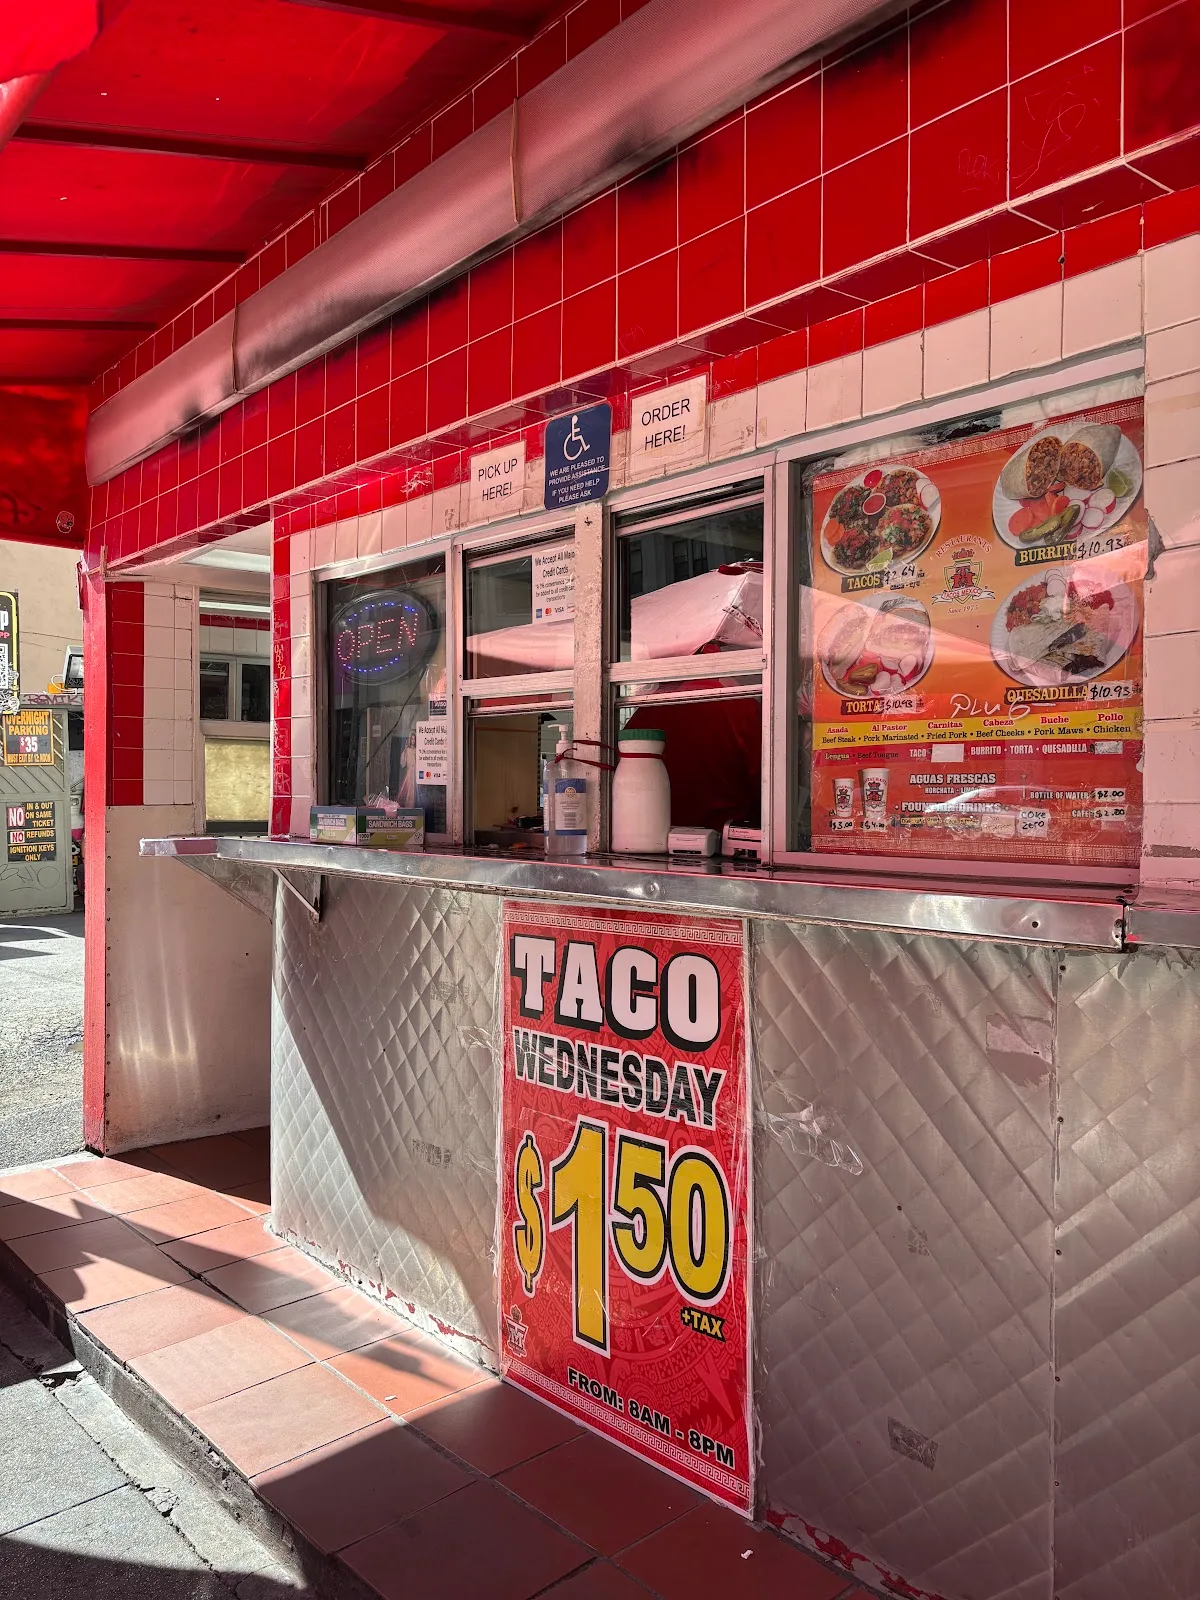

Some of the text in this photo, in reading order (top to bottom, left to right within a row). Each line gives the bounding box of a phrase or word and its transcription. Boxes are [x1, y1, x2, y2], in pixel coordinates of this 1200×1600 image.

[641, 399, 691, 427] ORDER
[644, 424, 686, 450] HERE!
[478, 458, 518, 481] PICK UP
[559, 466, 570, 474] ARE
[571, 459, 595, 471] PLEASED
[596, 455, 605, 463] TO
[548, 464, 606, 486] PROVIDE ASSISTANCE
[482, 482, 512, 501] HERE!
[558, 486, 569, 494] YOU
[569, 481, 584, 491] NEED
[585, 478, 600, 487] HELP
[559, 489, 592, 503] PLEASE ASK
[935, 534, 993, 559] RESTAURANTS
[542, 553, 557, 565] Accept
[543, 567, 556, 578] Credit
[847, 574, 881, 590] TACOS
[337, 612, 418, 661] OPEN
[1007, 685, 1089, 702] QUESADILLA
[846, 699, 881, 713] TORTA
[6, 711, 50, 725] OVERNIGHT
[871, 724, 880, 732] Al
[881, 724, 908, 732] Pastor
[927, 721, 963, 730] Carnitas
[983, 718, 1014, 727] Cabeza
[1040, 715, 1070, 725] Buche
[1097, 712, 1124, 722] Pollo
[8, 725, 49, 736] PARKING
[822, 736, 837, 744] Beef
[926, 731, 947, 740] Fried
[948, 731, 968, 739] Pork
[975, 729, 994, 739] Beef
[995, 728, 1025, 737] Cheeks
[1033, 728, 1055, 737] Pork
[1057, 726, 1084, 735] Maws
[1093, 724, 1132, 734] Chicken
[20, 736, 38, 753] $35
[909, 749, 927, 757] TACO
[970, 746, 1001, 755] BURRITO
[1009, 744, 1034, 754] TORTA
[1041, 743, 1088, 754] QUESADILLA
[909, 773, 997, 785] AGUAS FRESCAS
[1030, 790, 1054, 799] BOTTLE
[1055, 791, 1064, 799] OF
[1065, 791, 1089, 800] WATER
[9, 807, 25, 827] NO
[26, 802, 34, 810] IN
[40, 802, 53, 810] OUT
[25, 811, 52, 819] ON SAME
[959, 802, 1003, 813] DRINKS
[1071, 809, 1089, 818] CAFE
[32, 819, 54, 828] TICKET
[368, 820, 413, 828] SANDWICH BAGS
[12, 830, 55, 843] NO REFUNDS
[10, 844, 55, 854] IGNITION KEYS
[25, 853, 41, 862] ONLY
[511, 933, 721, 1052] TACO
[512, 1026, 728, 1128] WEDNESDAY
[681, 1306, 726, 1342] +TAX
[567, 1366, 625, 1411] FROM:
[629, 1398, 672, 1437] 8AM
[688, 1428, 736, 1470] 8PM
